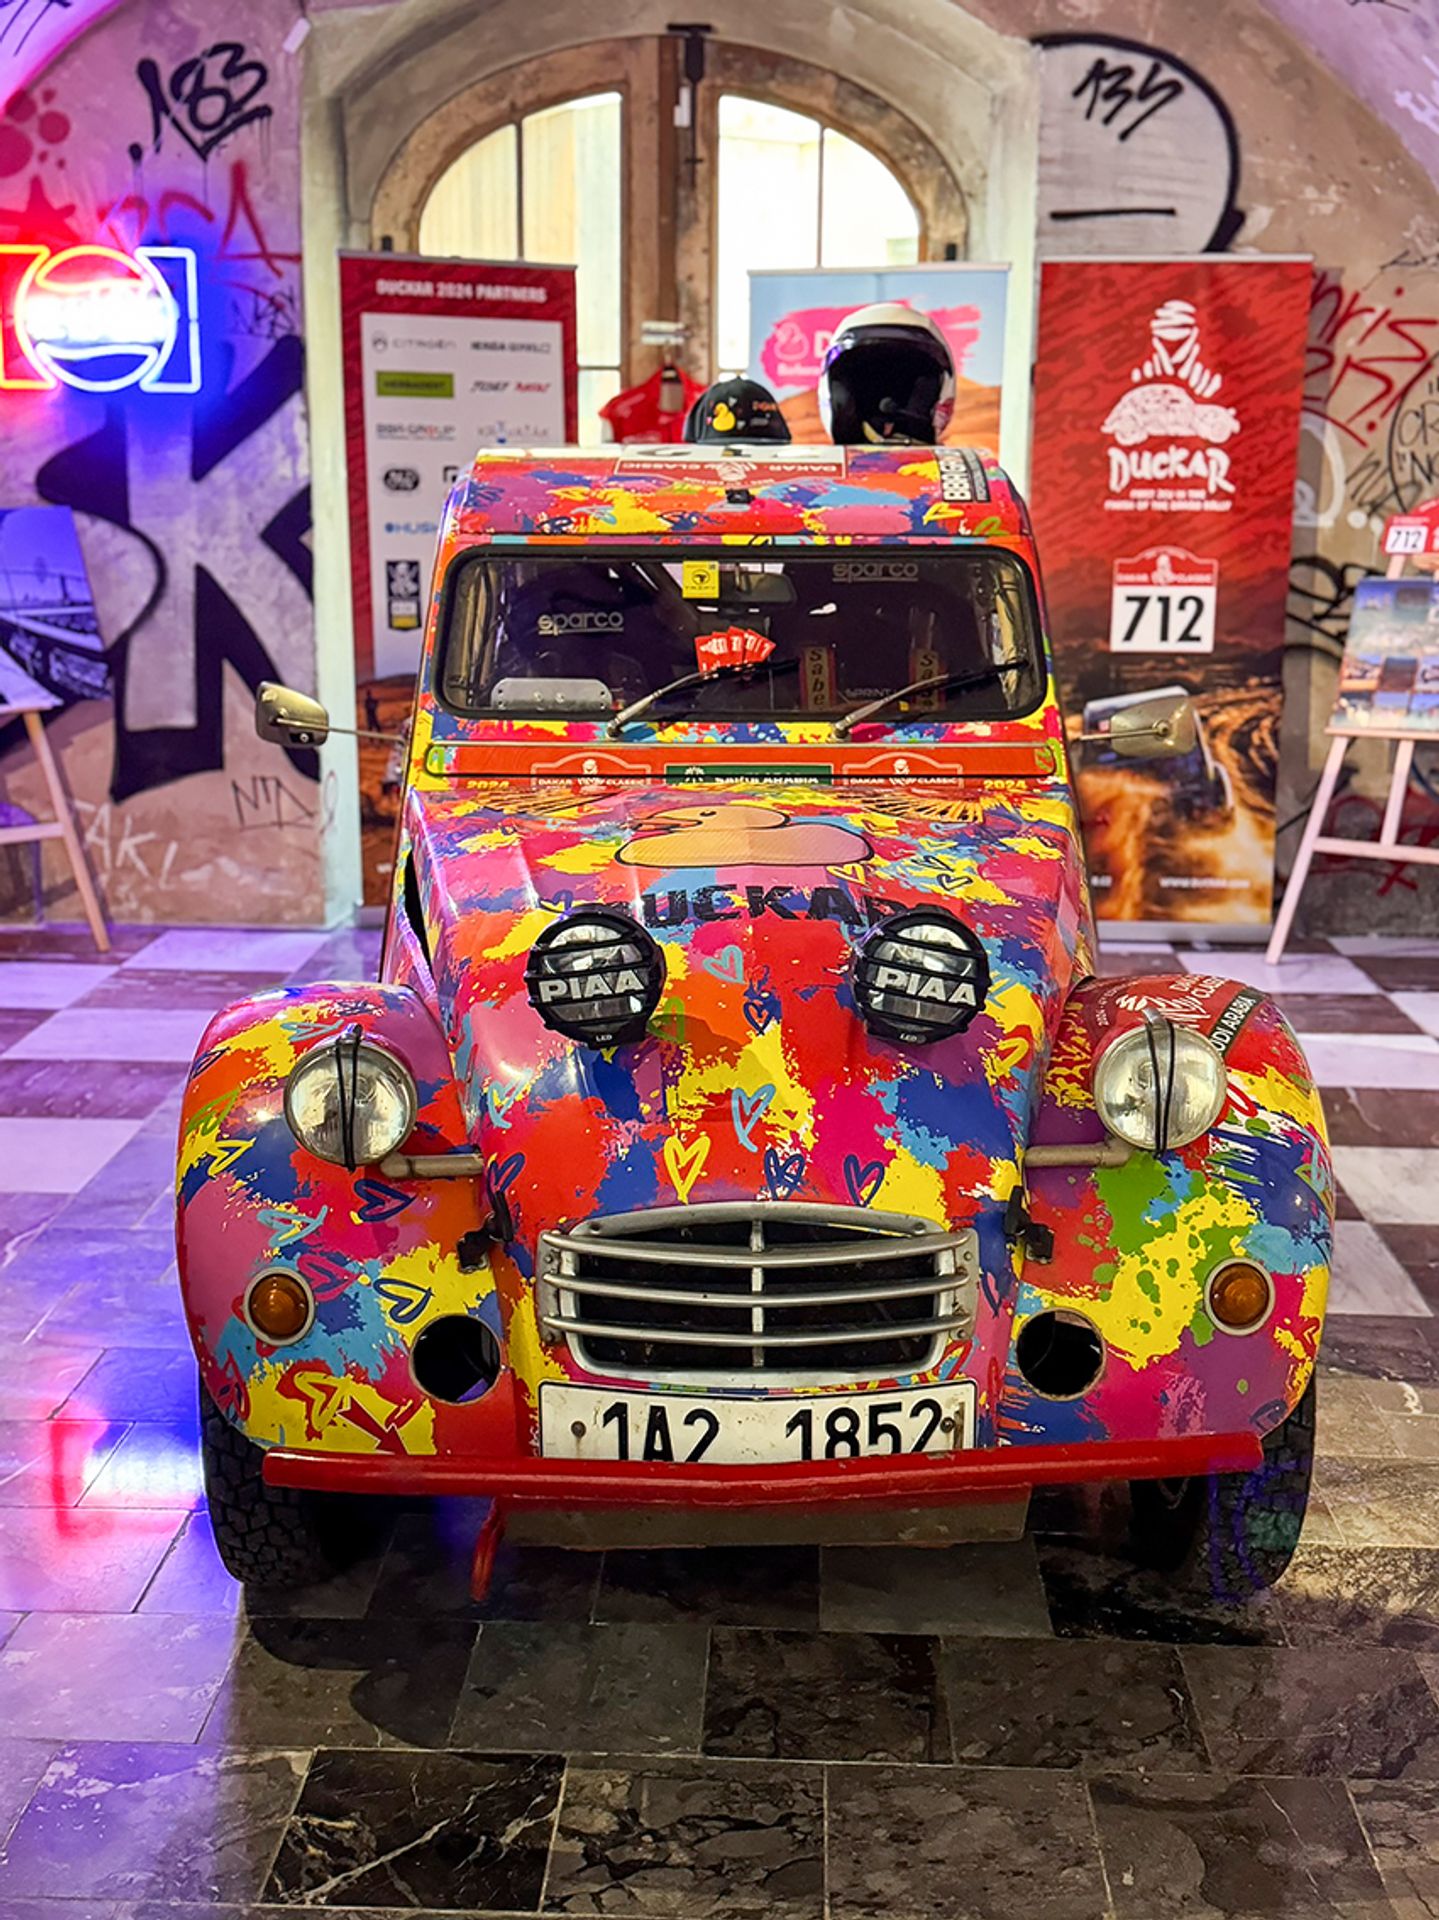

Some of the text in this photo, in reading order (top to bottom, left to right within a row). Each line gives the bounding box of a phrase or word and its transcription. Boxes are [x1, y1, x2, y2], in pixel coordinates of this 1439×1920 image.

[376, 279, 548, 304] DUCKAR 2024 PARTNERS
[1107, 445, 1236, 493] DUCKAR
[1391, 530, 1422, 549] 712
[833, 562, 918, 583] sparco
[538, 611, 624, 634] sparco
[1122, 595, 1204, 643] 712
[849, 777, 958, 785] DAKAR CLASSIC
[983, 779, 1028, 791] 2024
[538, 969, 645, 1003] PIAA
[875, 965, 977, 1007] PIAA
[596, 1034, 613, 1042] LED
[900, 1033, 918, 1042] LED
[602, 1398, 943, 1462] 1A2 1852
